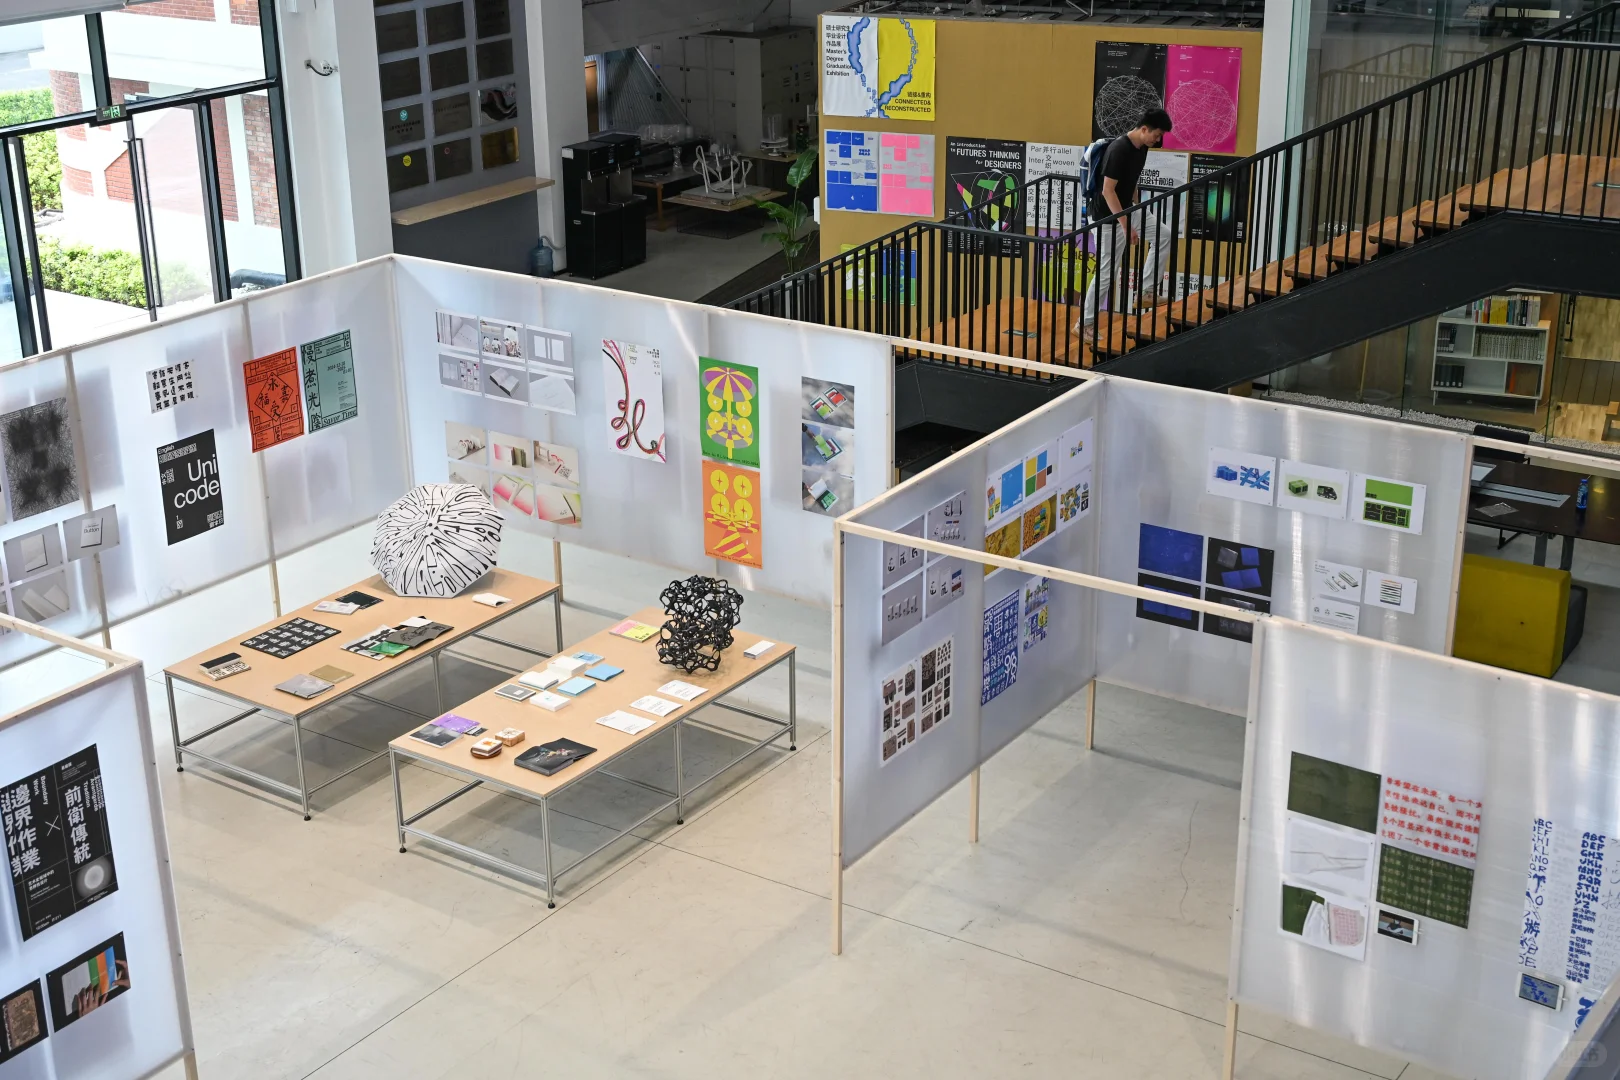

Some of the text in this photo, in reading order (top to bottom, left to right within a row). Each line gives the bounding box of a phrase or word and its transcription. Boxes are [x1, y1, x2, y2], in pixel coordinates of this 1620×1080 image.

[895, 98, 932, 106] CONNECTED&
[884, 105, 932, 113] RECONSTRUCTED
[956, 148, 987, 158] FUTURES
[989, 150, 1020, 160] THINKING
[984, 159, 1022, 170] DESIGNERS
[187, 453, 218, 482] Uni
[174, 478, 220, 509] code
[40, 775, 48, 805] Boundary
[11, 784, 41, 873] 邊界作業
[65, 785, 92, 865] 前衛傳統
[1582, 831, 1606, 843] ABC
[1581, 840, 1605, 851] DEF
